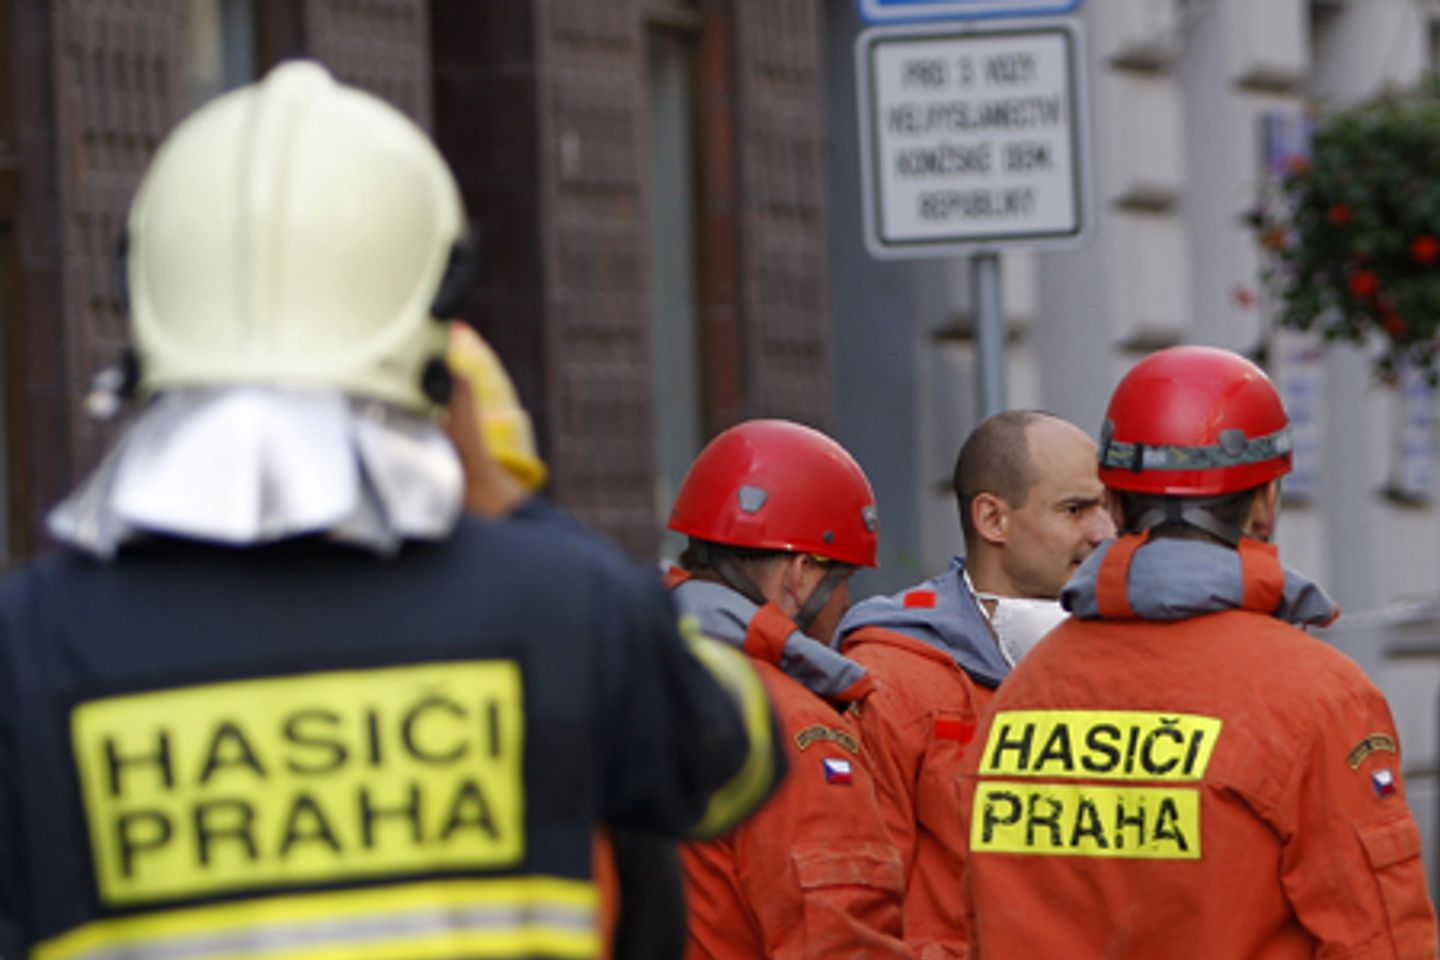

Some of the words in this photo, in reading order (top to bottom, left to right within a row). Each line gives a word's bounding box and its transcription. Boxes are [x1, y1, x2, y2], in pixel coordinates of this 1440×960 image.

[103, 680, 503, 798] HASIČI
[990, 717, 1205, 775] HASIČI
[114, 777, 500, 878] PRAHA
[981, 791, 1190, 852] PRAHA
